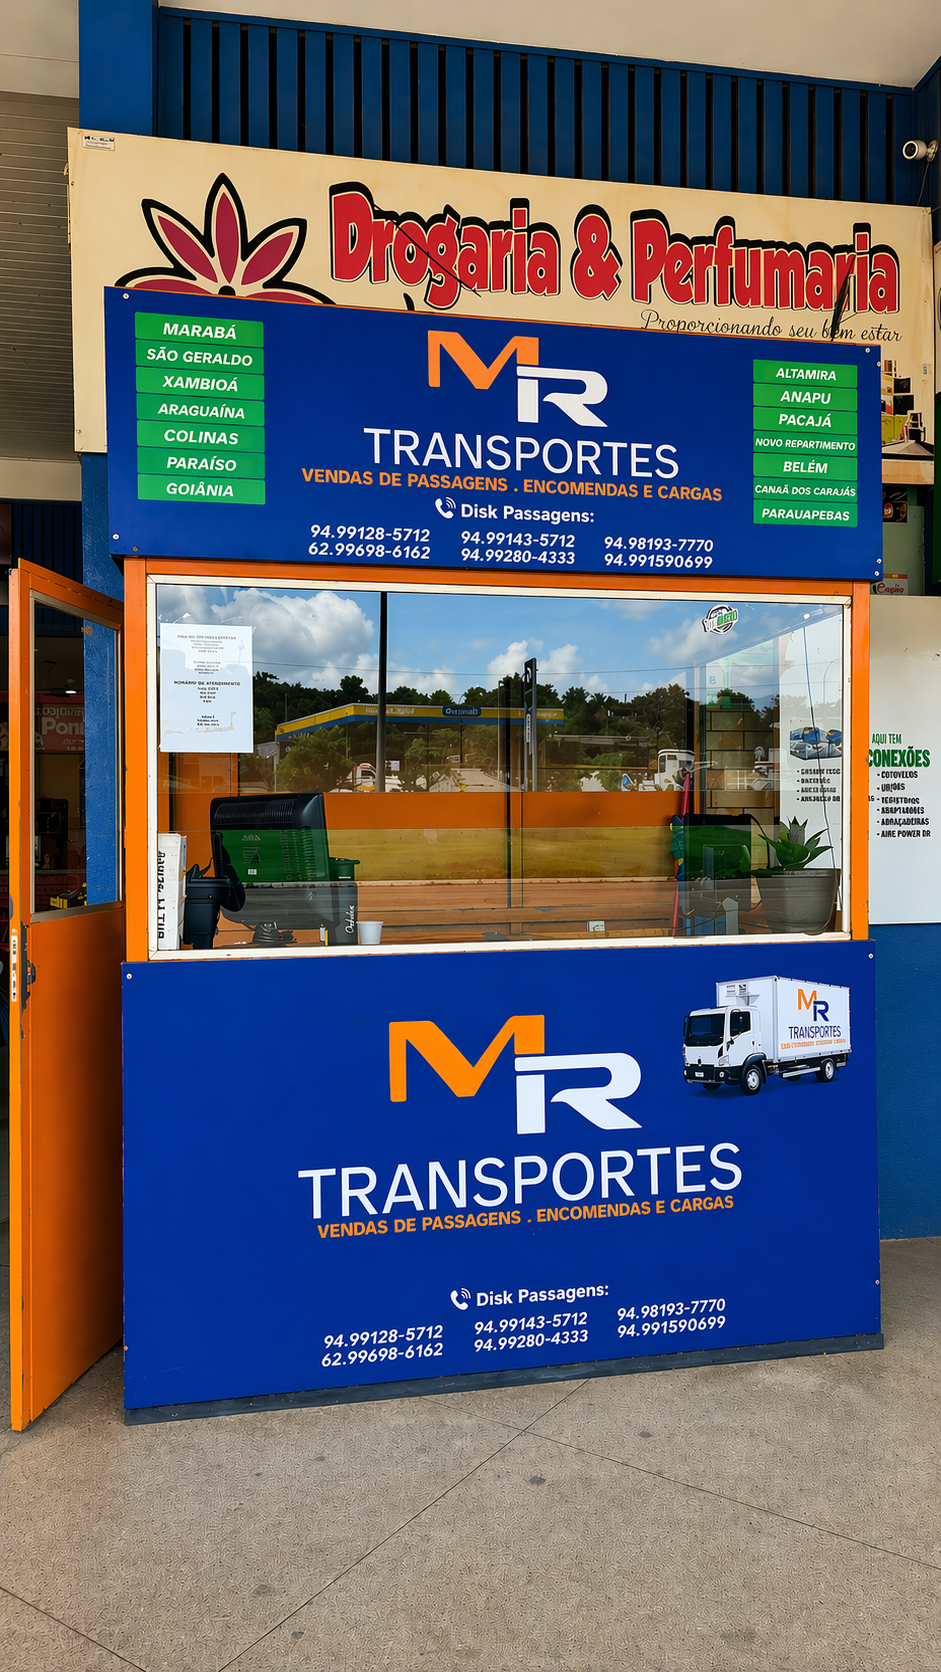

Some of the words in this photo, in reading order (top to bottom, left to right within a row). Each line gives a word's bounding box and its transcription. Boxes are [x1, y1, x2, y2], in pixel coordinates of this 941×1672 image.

[329, 181, 561, 310] Drogaria
[570, 204, 623, 300] &
[630, 209, 900, 313] Perfumaria
[162, 322, 237, 340] MARABÁ
[641, 309, 783, 337] Proporcionando
[788, 327, 818, 338] seu
[860, 323, 904, 342] estar
[146, 346, 179, 362] SÃO
[182, 350, 253, 367] GERALDO
[428, 330, 608, 428] MR
[775, 367, 837, 381] ALTAMIRA
[162, 375, 238, 392] XAMBIOÁ
[780, 390, 832, 405] ANAPU
[157, 402, 245, 420] ARAGUAÍNA
[778, 413, 832, 428] PACAJÁ
[163, 429, 239, 445] COLINAS
[755, 437, 783, 448] NOVO
[785, 440, 856, 451] REPARTIMENTO
[363, 427, 679, 479] TRANSPORTES
[166, 454, 237, 472] PARAÍSO
[782, 459, 828, 474] BELÉM
[166, 481, 234, 497] GOIÂNIA
[302, 467, 374, 486] VENDAS
[380, 471, 402, 487] DE
[407, 472, 508, 492] PASSAGENS
[523, 478, 639, 498] ENCOMENDAS
[643, 484, 653, 498] E
[657, 485, 723, 502] CARGAS
[791, 486, 811, 496] DOS
[813, 486, 856, 497] CARAJÁS
[461, 503, 498, 519] Disk
[503, 505, 595, 525] Passagens:
[761, 508, 850, 521] PARAUAPEBAS
[310, 524, 431, 542] 94.99128-5712
[461, 531, 576, 548] 94.99143-5712
[308, 541, 431, 560] 62.99698-6162
[604, 536, 714, 552] 94.98193-7770
[461, 547, 576, 565] 94.99280-4333
[604, 553, 713, 569] 94.991590699
[872, 733, 887, 745] AQUI
[888, 733, 902, 744] TEM
[868, 746, 931, 768] CONEXÕES
[797, 988, 830, 1022] MR
[788, 1025, 842, 1040] TRANSPORTES
[388, 1014, 643, 1135] MR
[297, 1142, 742, 1220] TRANSPORTES
[317, 1219, 389, 1239] VENDAS
[393, 1217, 417, 1233] DE
[422, 1210, 522, 1231] PASSAGENS
[536, 1201, 651, 1223] ENCOMENDAS
[655, 1200, 666, 1214] E
[670, 1195, 734, 1213] CARGAS
[476, 1290, 513, 1307] Disk
[518, 1284, 609, 1303] Passagens:
[617, 1298, 726, 1321] 94.98193-7770
[474, 1311, 588, 1335] 94.99143-5712
[617, 1315, 726, 1338] 94.991590699
[324, 1324, 443, 1349] 94.99128-5712
[474, 1329, 589, 1353] 94.99280-4333
[321, 1342, 444, 1367] 62.99698-6162
